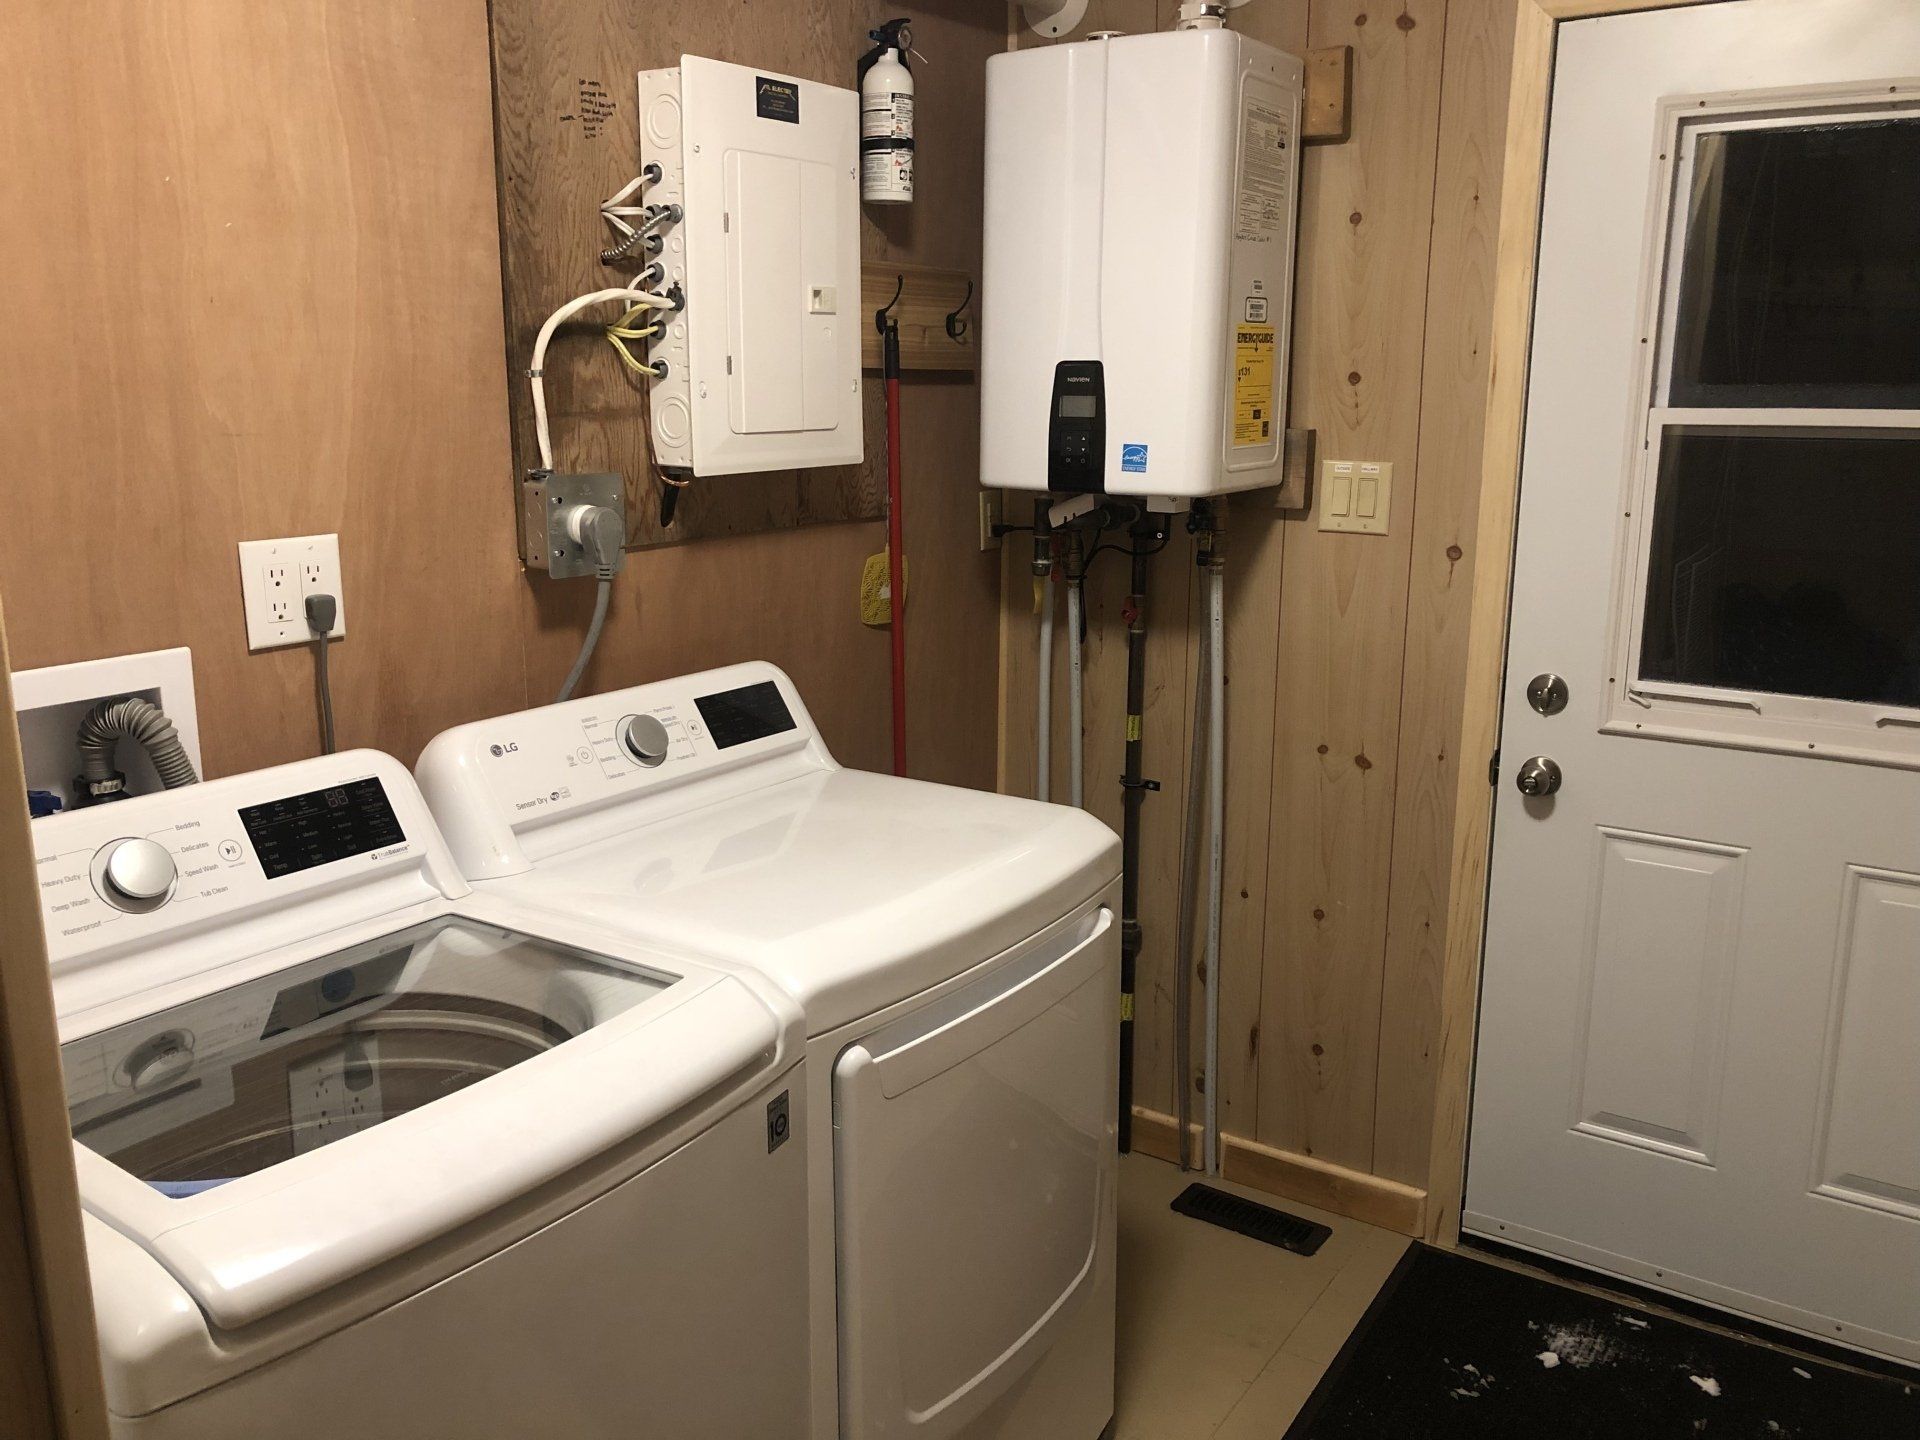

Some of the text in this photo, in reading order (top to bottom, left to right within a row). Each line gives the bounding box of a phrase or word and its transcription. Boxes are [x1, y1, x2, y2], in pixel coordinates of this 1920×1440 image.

[503, 742, 519, 754] LG
[515, 797, 548, 811] Sensor Dry
[175, 820, 201, 831] Bedding
[181, 841, 210, 853] Delicates
[36, 854, 58, 864] ormal
[184, 868, 203, 878] Speed
[202, 863, 219, 873] Wash
[41, 873, 81, 888] Heavy Duty
[51, 898, 90, 913] Deep Wash
[62, 921, 102, 936] Waterproof
